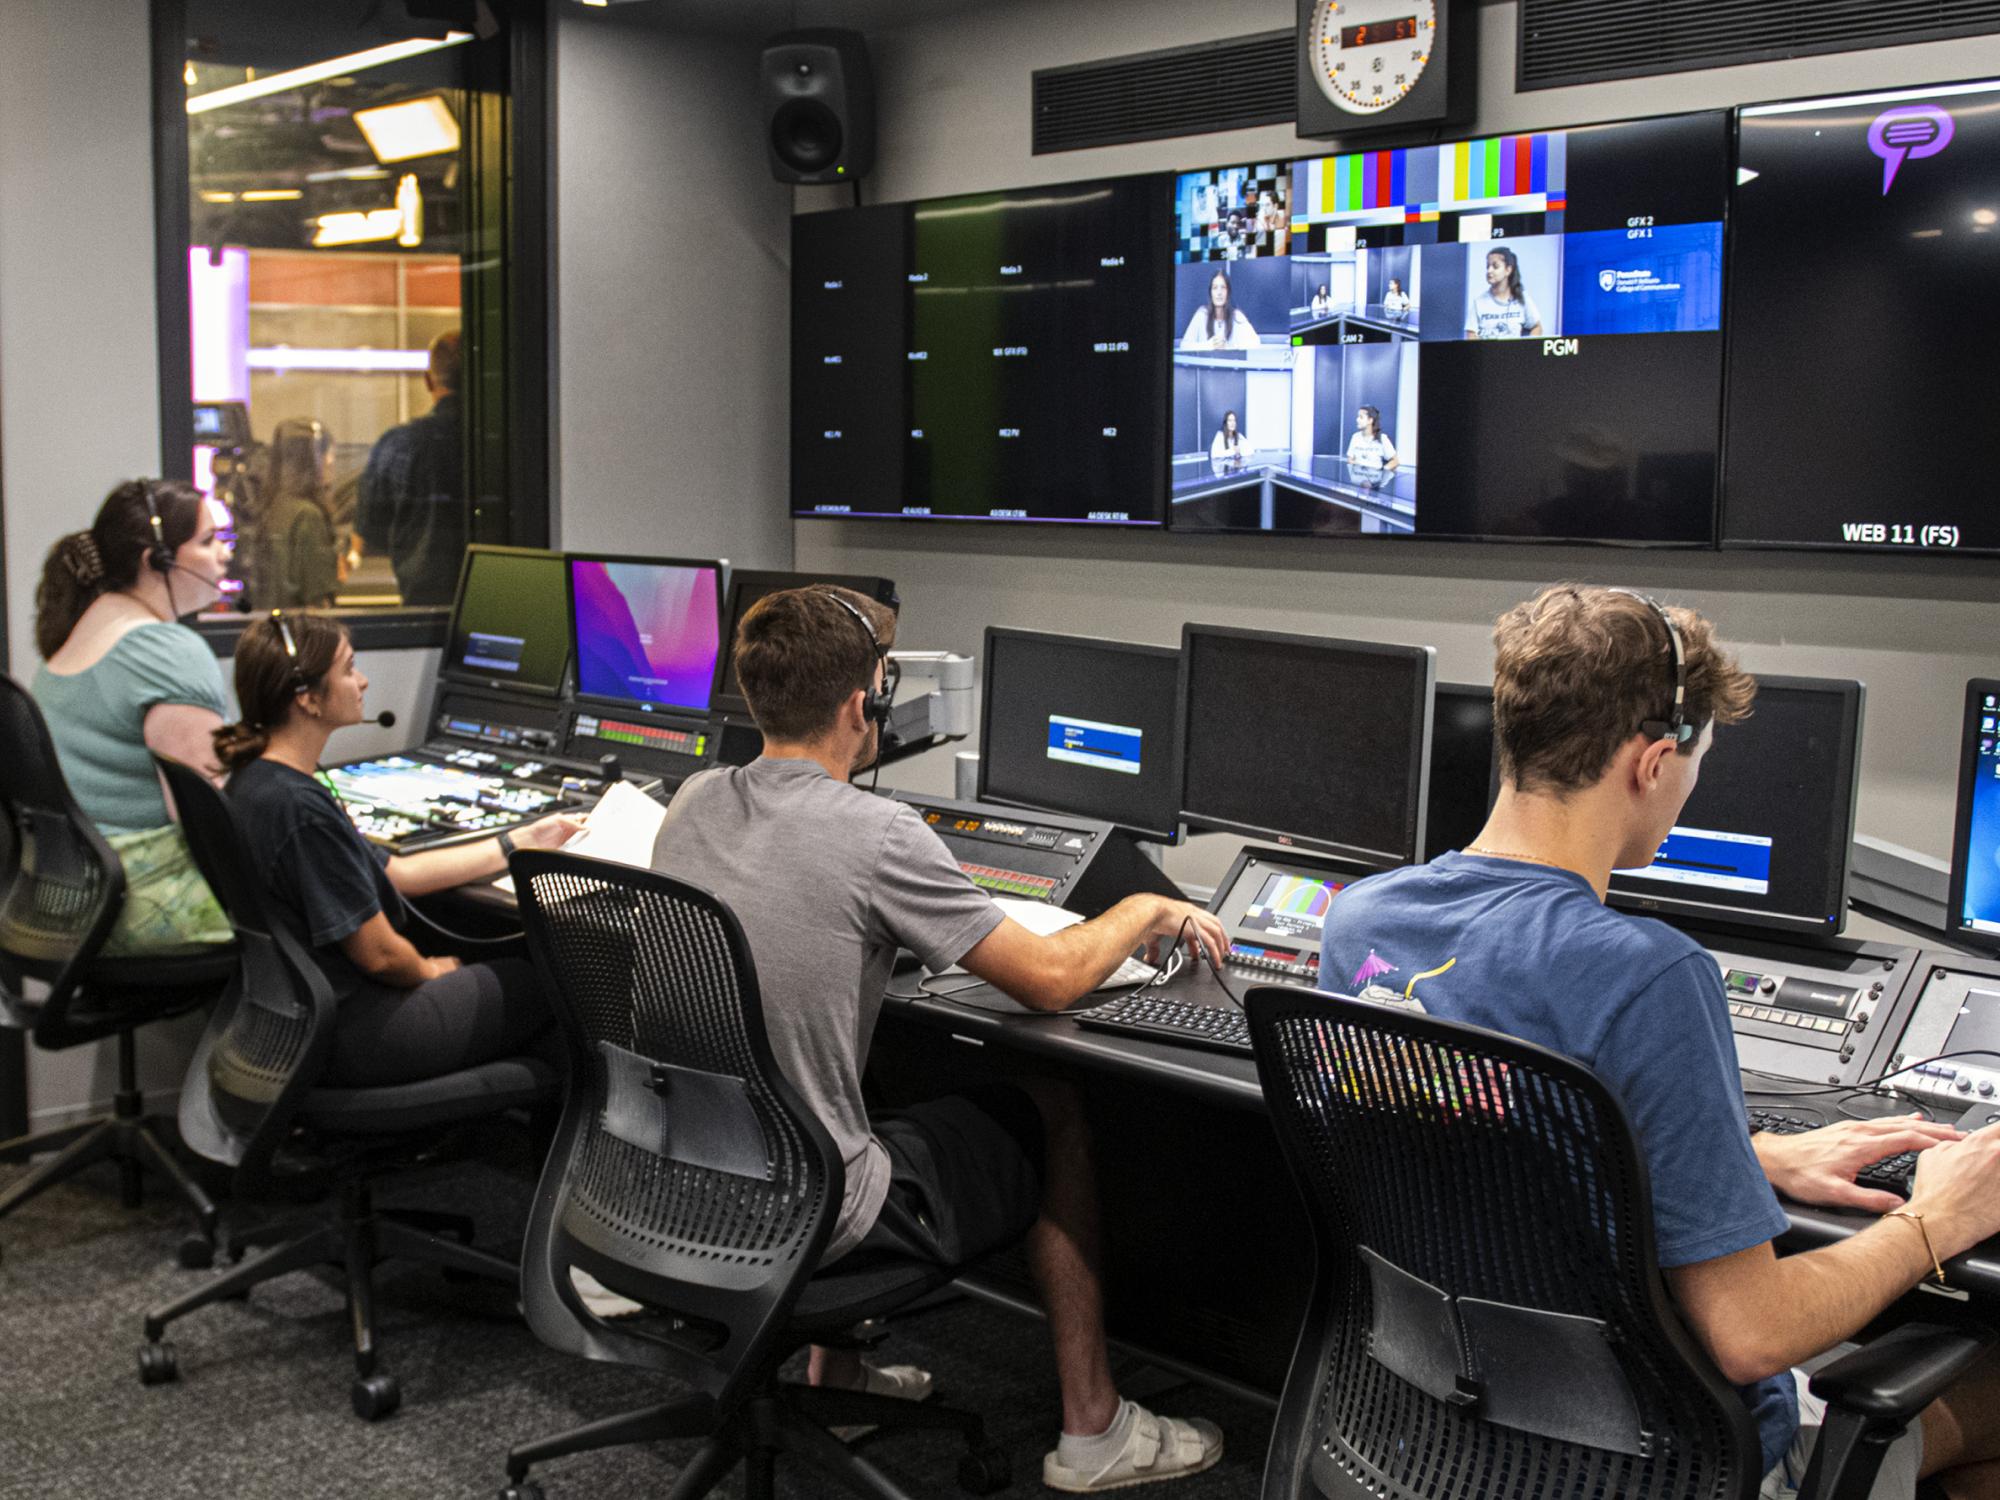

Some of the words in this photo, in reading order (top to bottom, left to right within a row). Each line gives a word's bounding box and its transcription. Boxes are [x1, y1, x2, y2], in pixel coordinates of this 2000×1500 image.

[1395, 73, 1406, 84] 25
[1351, 80, 1361, 90] 35
[1372, 84, 1383, 95] 30
[1627, 217, 1646, 227] GFX
[1647, 216, 1654, 226] 2
[1627, 229, 1646, 239] GFX
[1647, 228, 1653, 238] 1
[1341, 334, 1357, 343] CAM
[1358, 334, 1364, 343] 2
[1543, 338, 1579, 356] PGM
[1842, 523, 1886, 542] WEB
[1890, 524, 1915, 544] 11
[1920, 525, 1960, 547] (FS)
